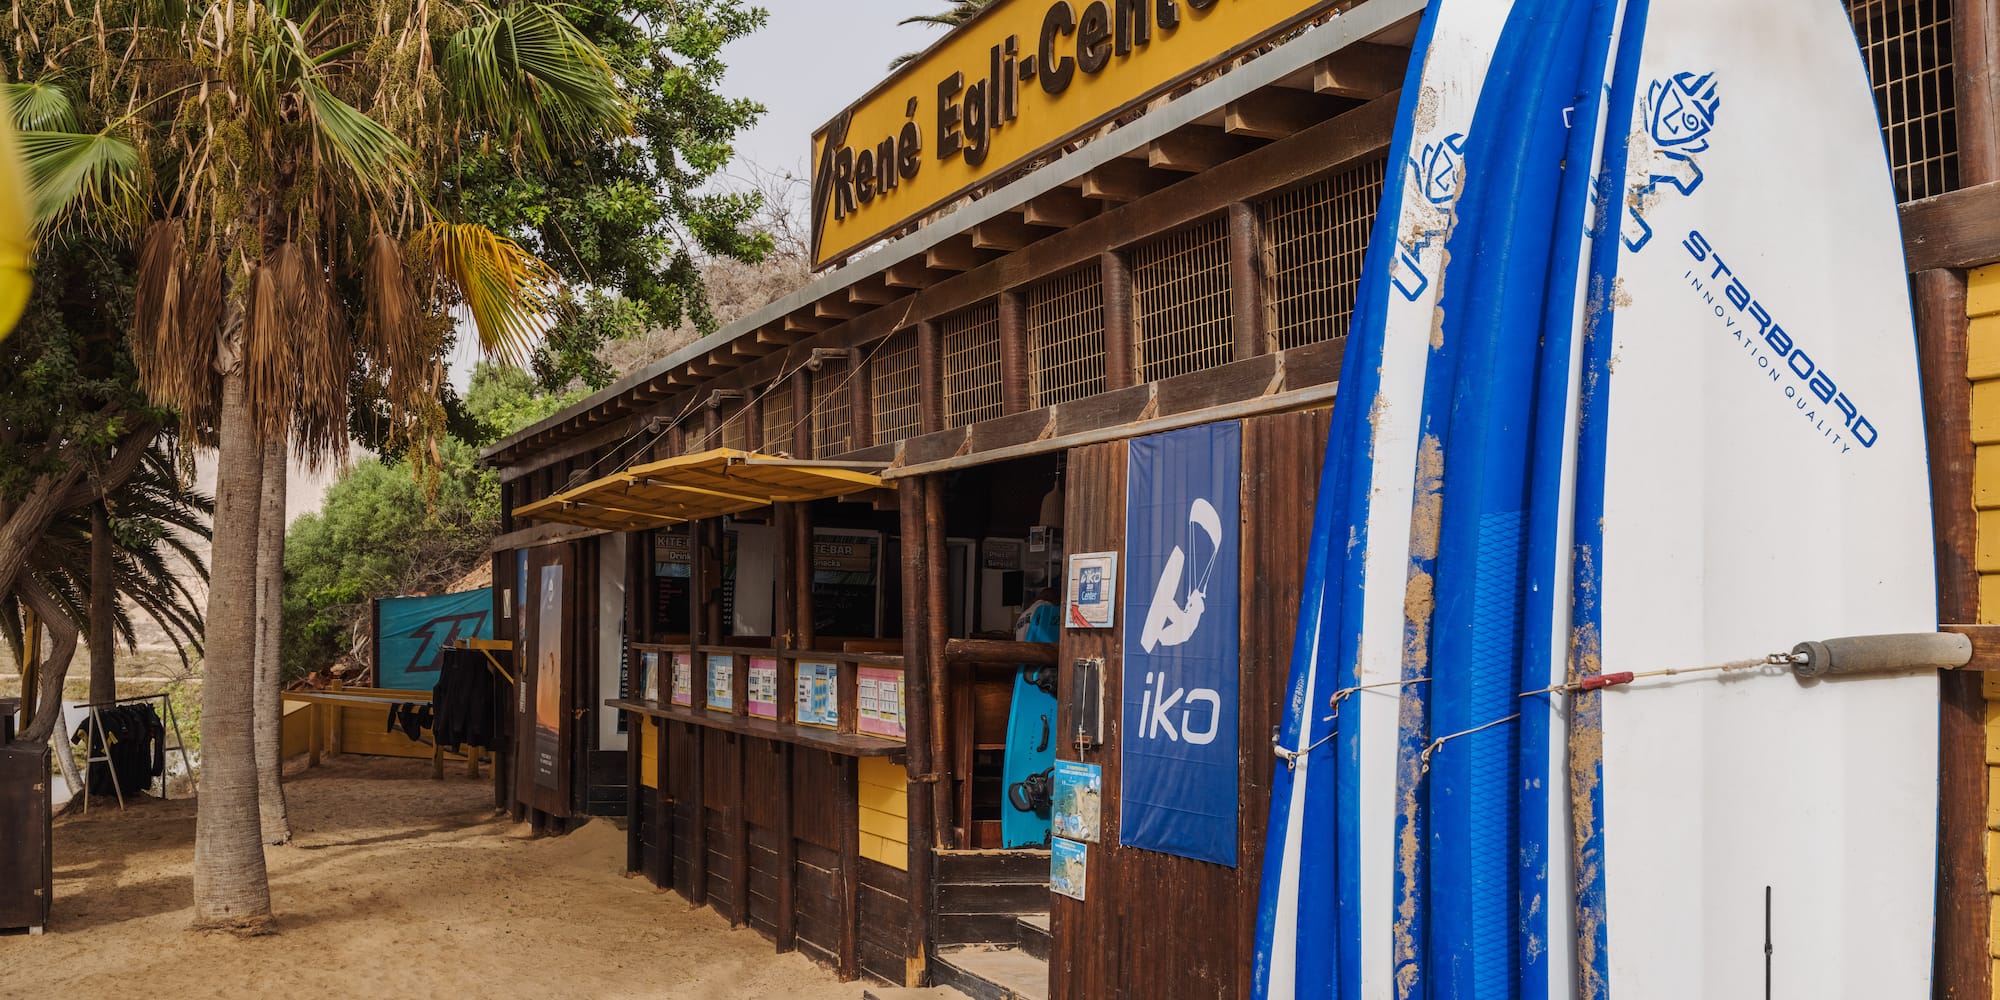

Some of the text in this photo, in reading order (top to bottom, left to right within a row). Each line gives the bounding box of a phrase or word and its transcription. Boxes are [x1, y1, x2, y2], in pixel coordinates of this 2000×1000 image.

[834, 0, 1219, 221] René Egli-Cen
[1684, 269, 1851, 455] INNOVATION QUALITY
[657, 536, 690, 547] KITE-
[813, 544, 853, 555] TE-BAR
[1138, 671, 1221, 745] iko
